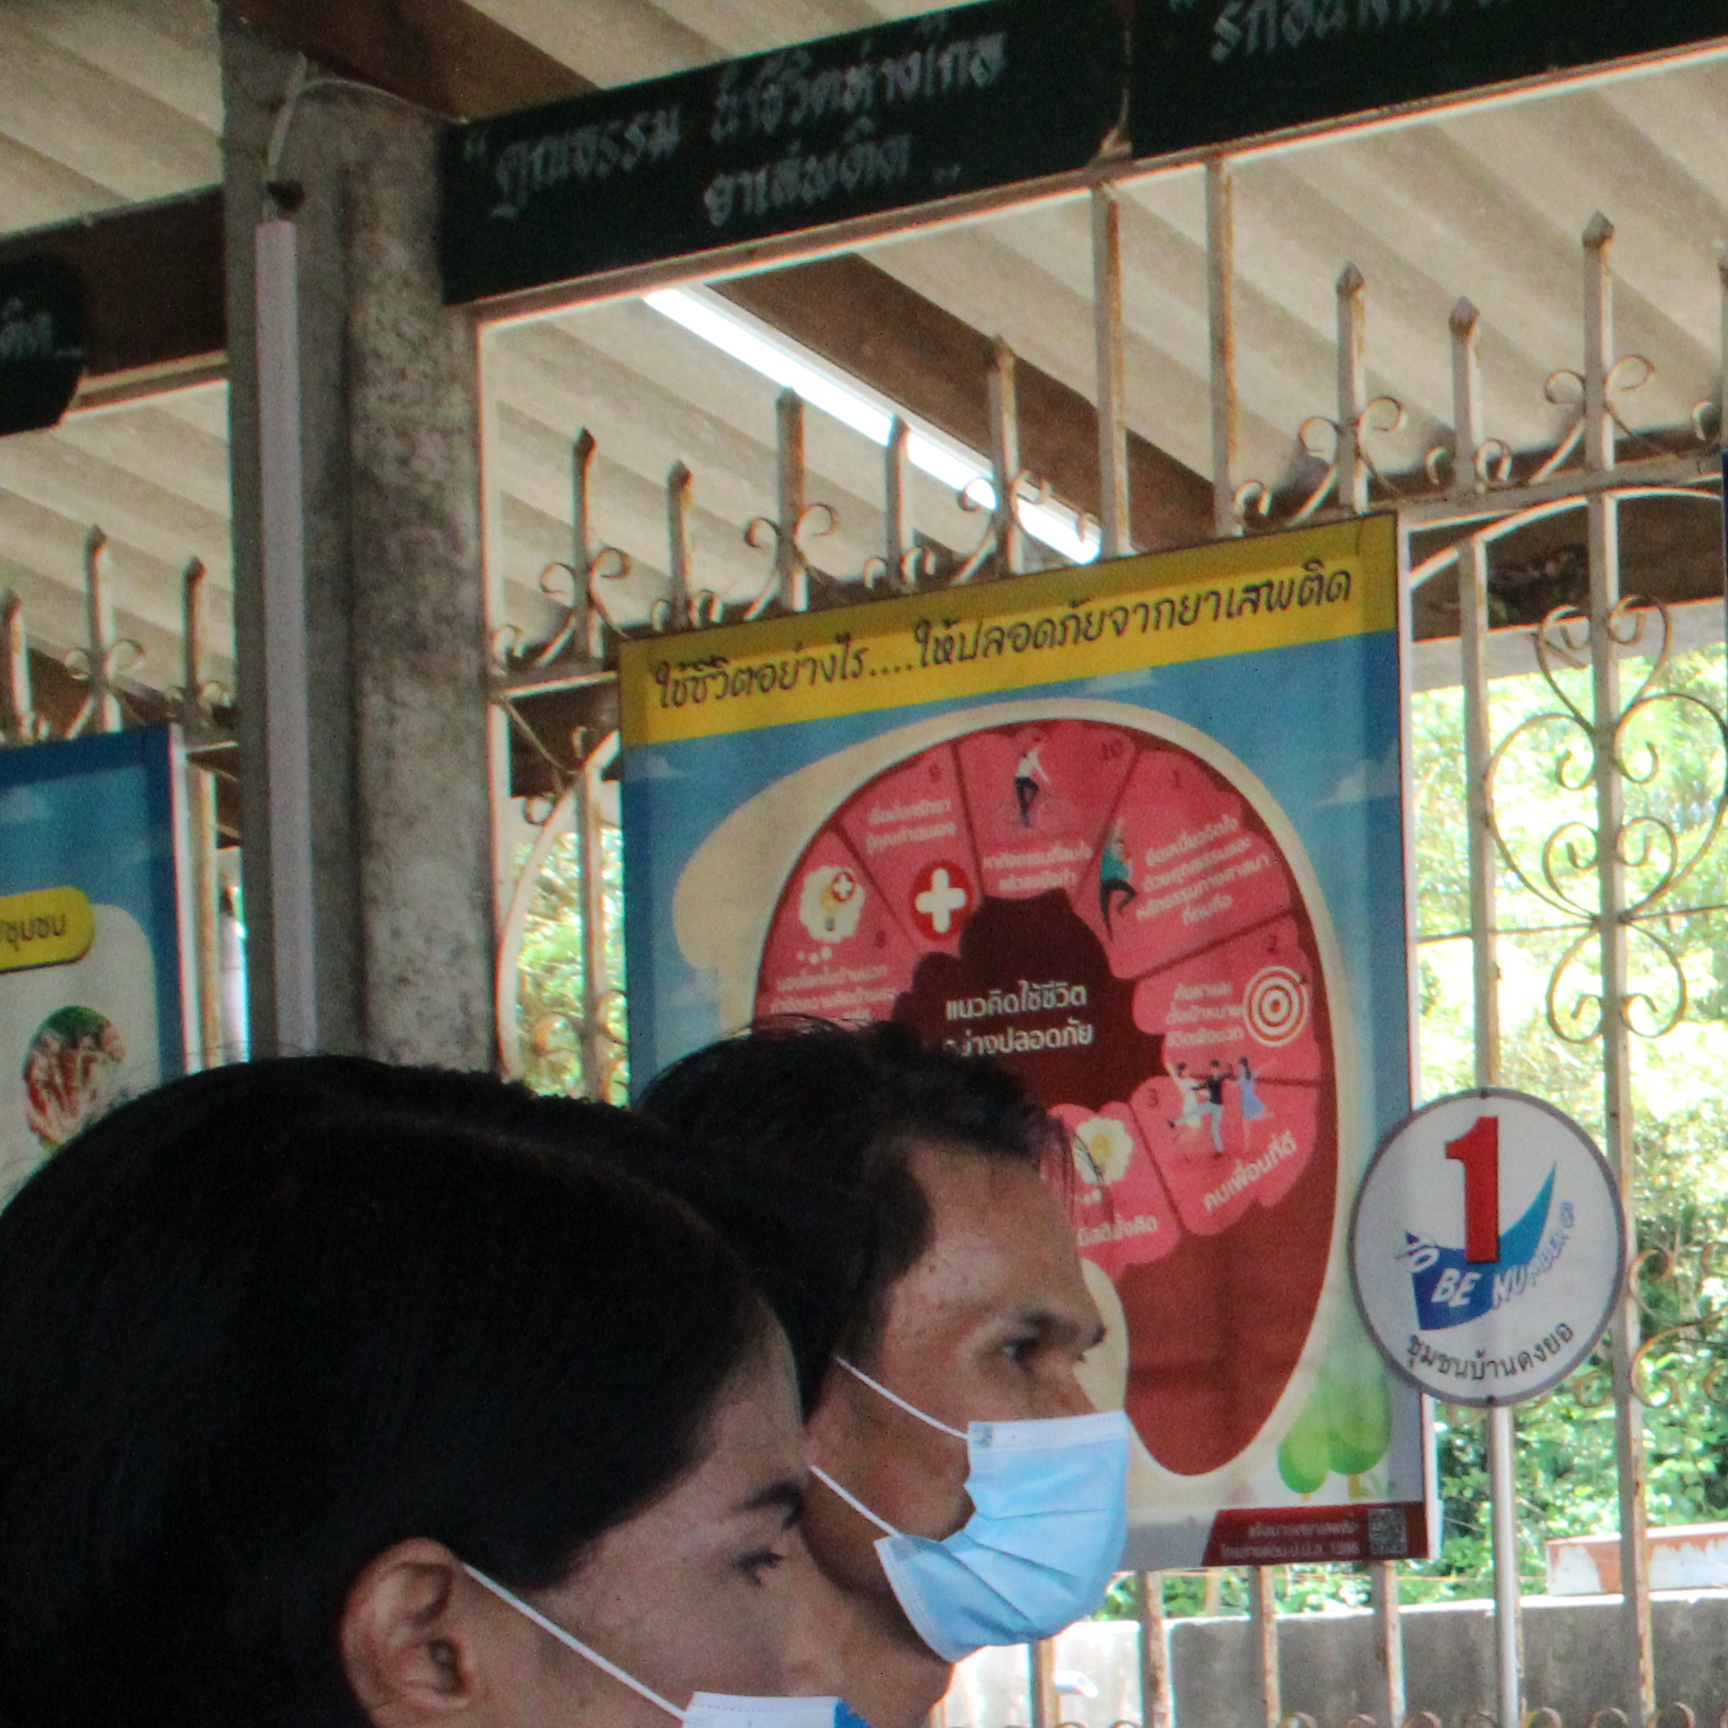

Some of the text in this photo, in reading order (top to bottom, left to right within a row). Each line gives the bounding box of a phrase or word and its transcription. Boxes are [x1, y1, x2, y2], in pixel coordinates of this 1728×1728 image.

[946, 980, 1087, 1021] แนวคิดใช้ชีวิต
[1445, 1116, 1499, 1264] 1
[1431, 1267, 1483, 1308] BE
